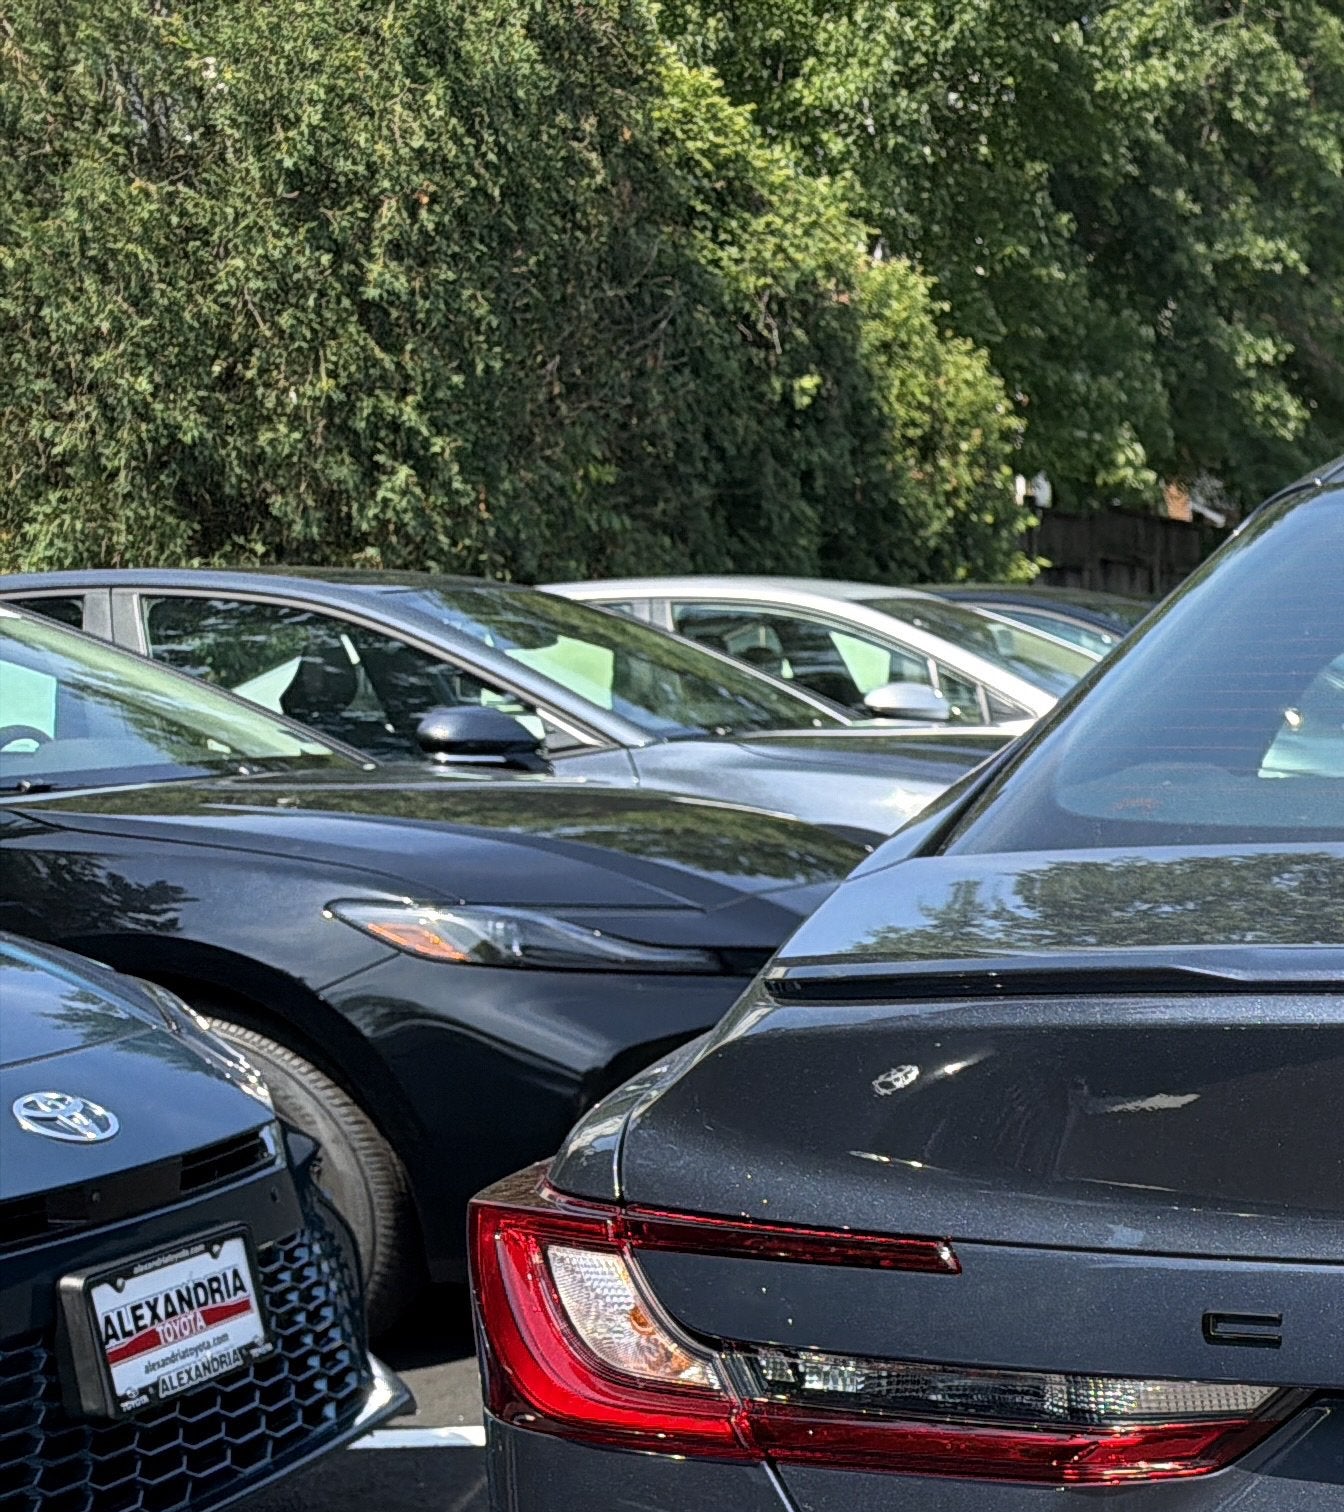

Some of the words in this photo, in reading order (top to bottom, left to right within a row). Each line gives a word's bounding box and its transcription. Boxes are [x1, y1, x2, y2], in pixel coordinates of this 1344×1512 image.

[103, 1268, 248, 1346] ALEXANDRIA
[156, 1312, 207, 1345] TOYOTA
[159, 1350, 244, 1398] ALEXANDRIA
